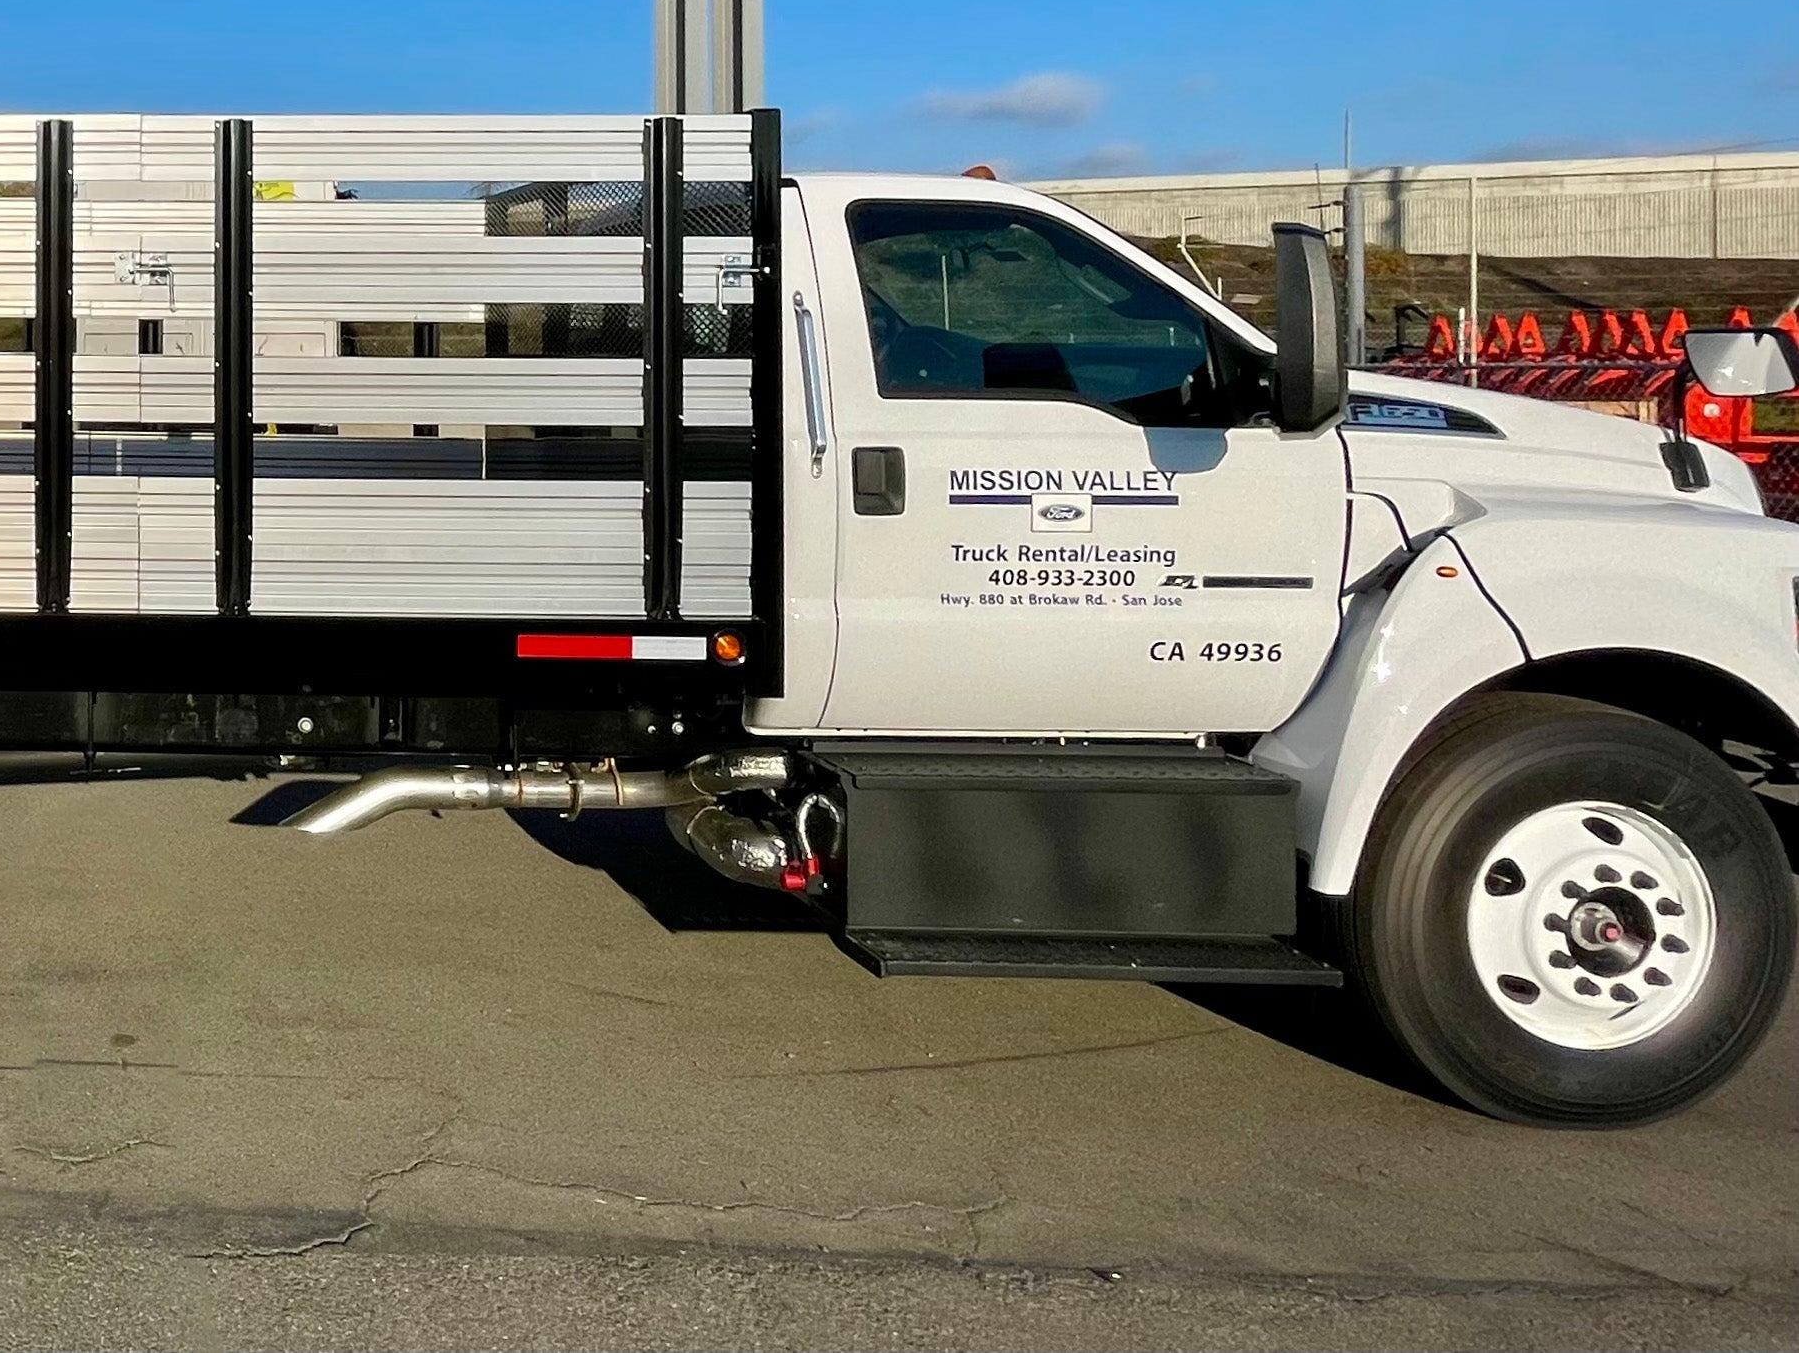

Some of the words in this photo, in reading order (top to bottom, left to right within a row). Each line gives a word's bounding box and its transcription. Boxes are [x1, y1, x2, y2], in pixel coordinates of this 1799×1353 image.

[950, 470, 1062, 491] MISSION
[1072, 470, 1178, 491] VALLEY
[951, 544, 1008, 562] Truck
[1018, 544, 1176, 567] Rental/Leasing
[988, 569, 1135, 586] 408-933-2300
[940, 594, 974, 608] Hwy.
[979, 594, 1004, 605] 880
[1009, 594, 1023, 605] at
[1029, 594, 1079, 606] Brokaw
[1085, 594, 1107, 605] Rd.
[1122, 595, 1147, 606] San
[1153, 595, 1183, 606] Jose
[1150, 642, 1185, 661] CA
[1199, 642, 1282, 662] 49936
